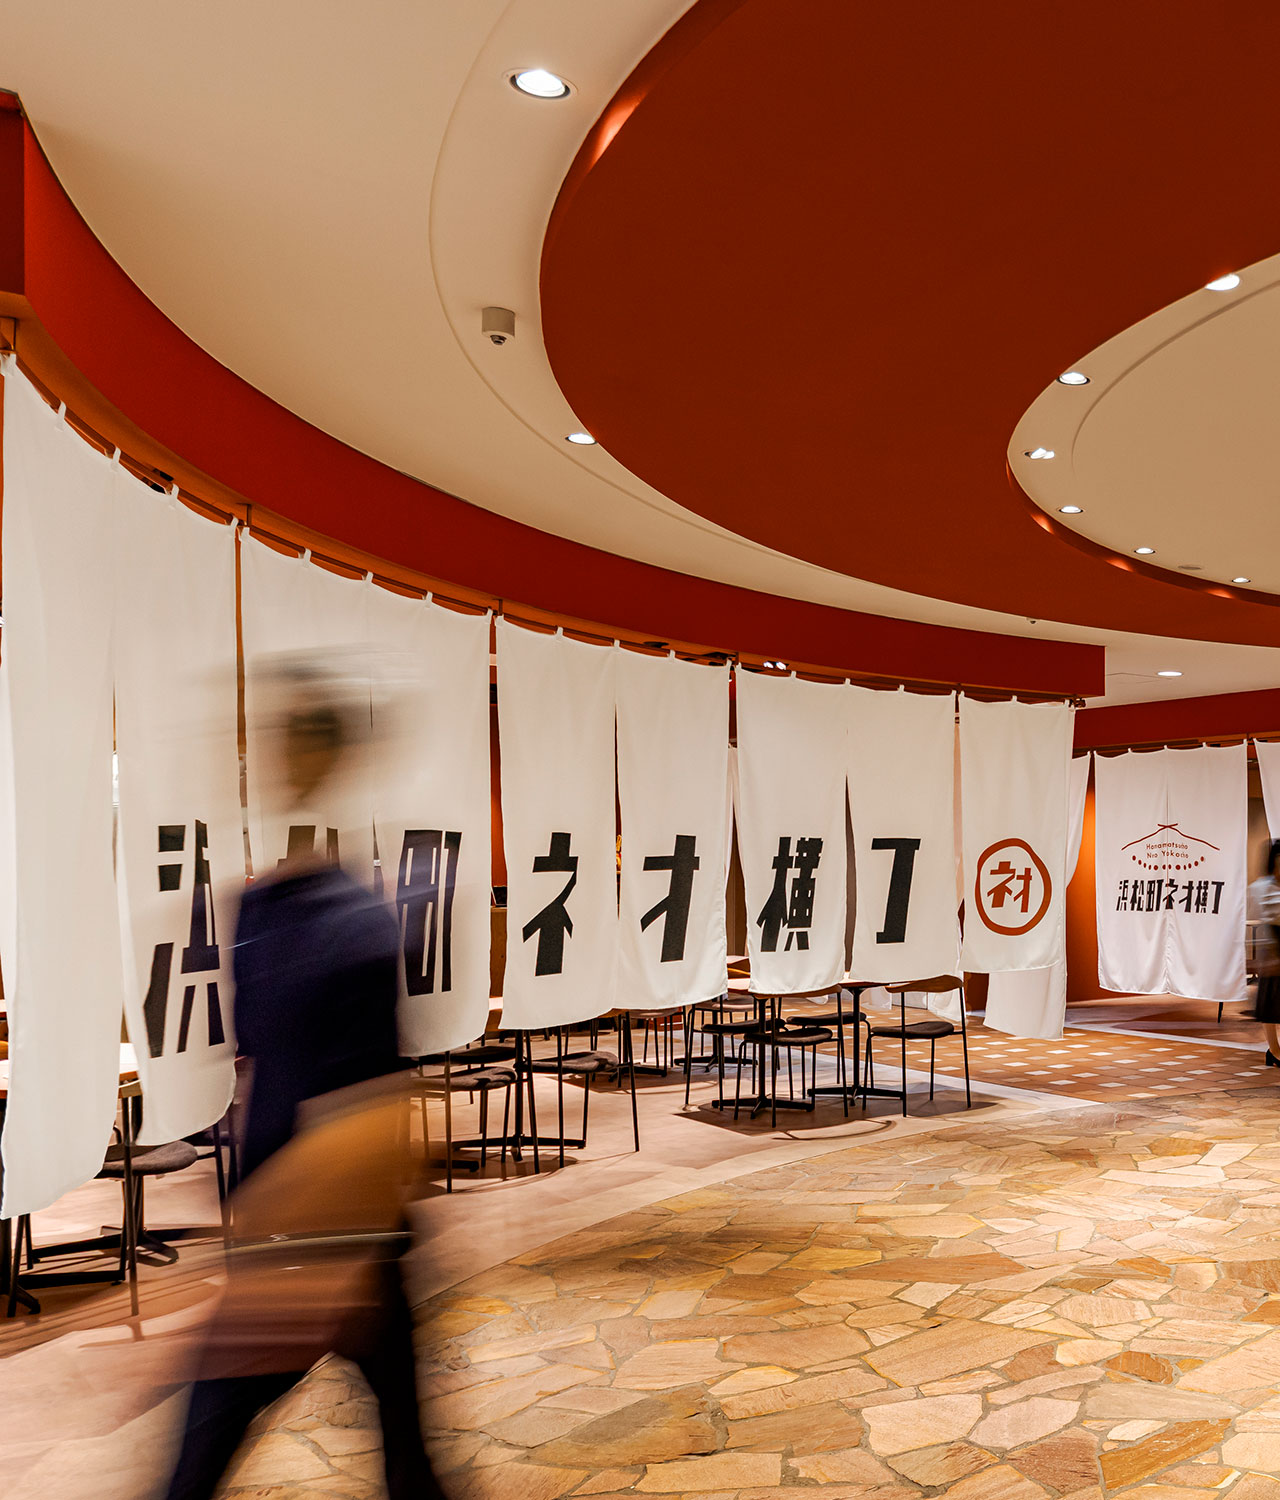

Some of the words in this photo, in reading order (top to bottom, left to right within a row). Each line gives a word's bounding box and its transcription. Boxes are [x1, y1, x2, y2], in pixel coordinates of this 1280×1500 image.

[1116, 878, 1225, 914] 浜松町ネオ横丁
